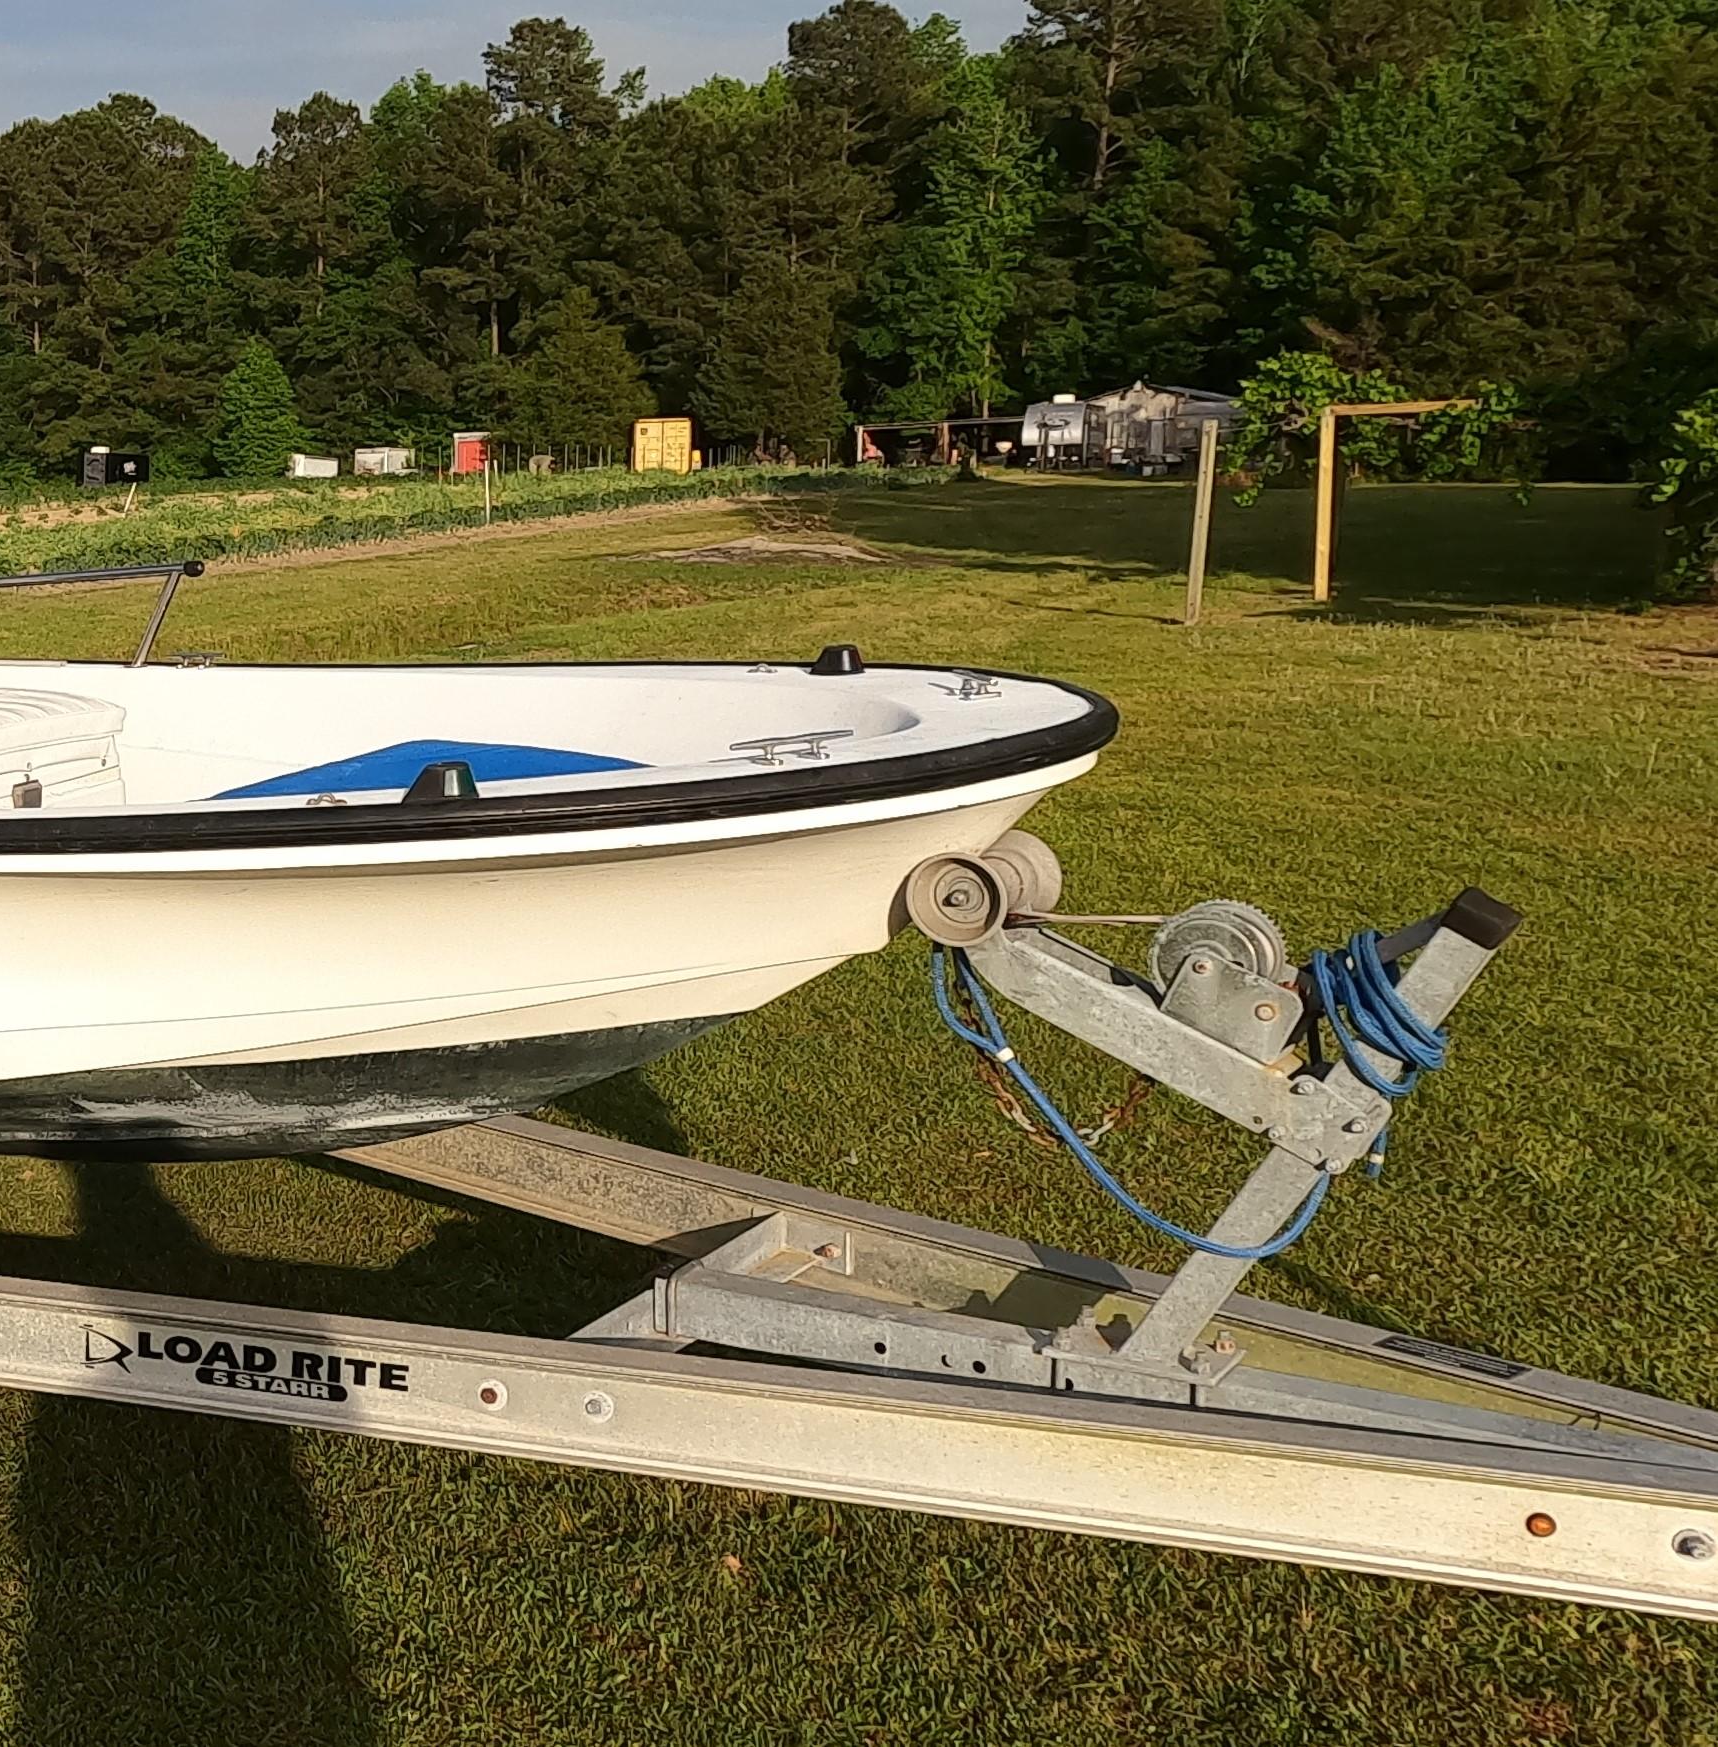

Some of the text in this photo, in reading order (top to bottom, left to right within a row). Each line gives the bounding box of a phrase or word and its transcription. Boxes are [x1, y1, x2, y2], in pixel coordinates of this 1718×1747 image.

[137, 1331, 410, 1392] LOAD RITE
[212, 1371, 330, 1400] 5 STARR
